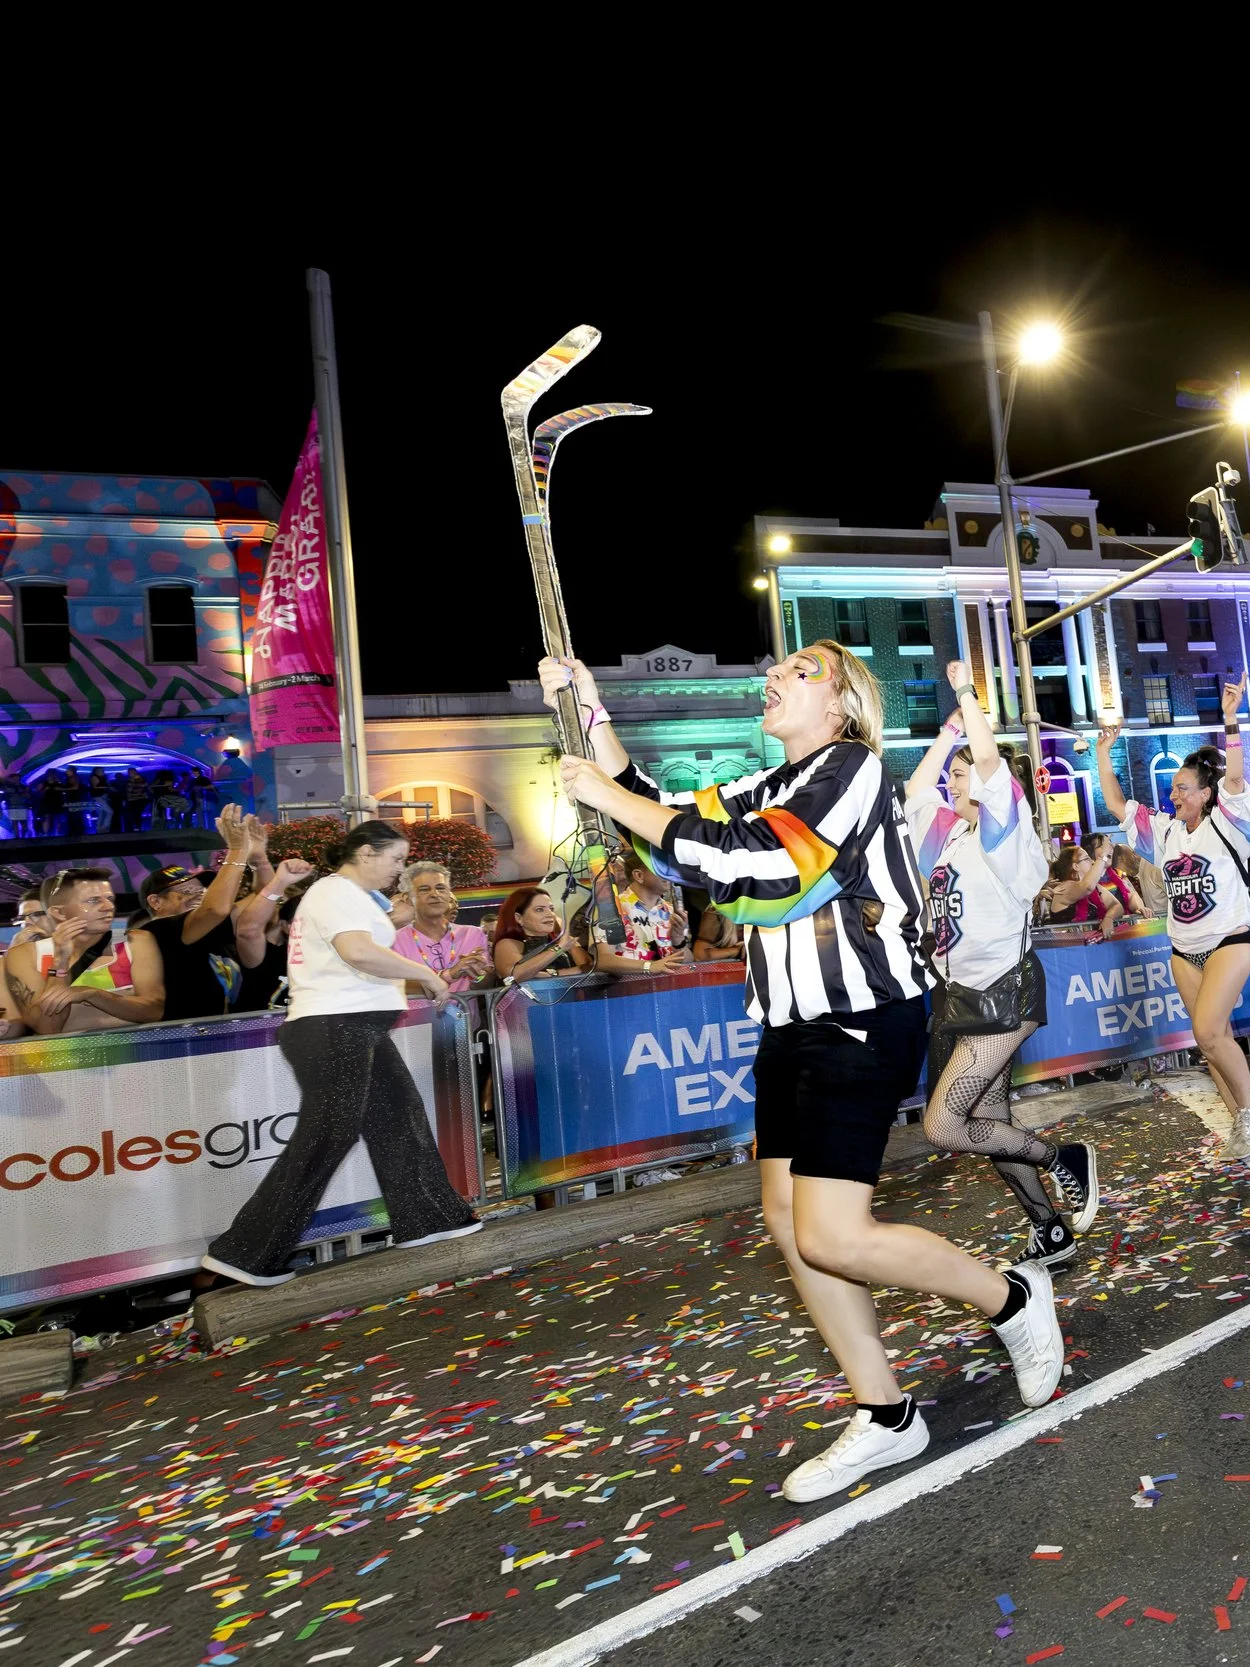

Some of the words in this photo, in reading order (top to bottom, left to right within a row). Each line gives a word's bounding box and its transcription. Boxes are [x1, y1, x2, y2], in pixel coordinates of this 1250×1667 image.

[647, 657, 693, 673] 1887
[1165, 875, 1215, 898] LIGHTS
[674, 1064, 757, 1116] EX
